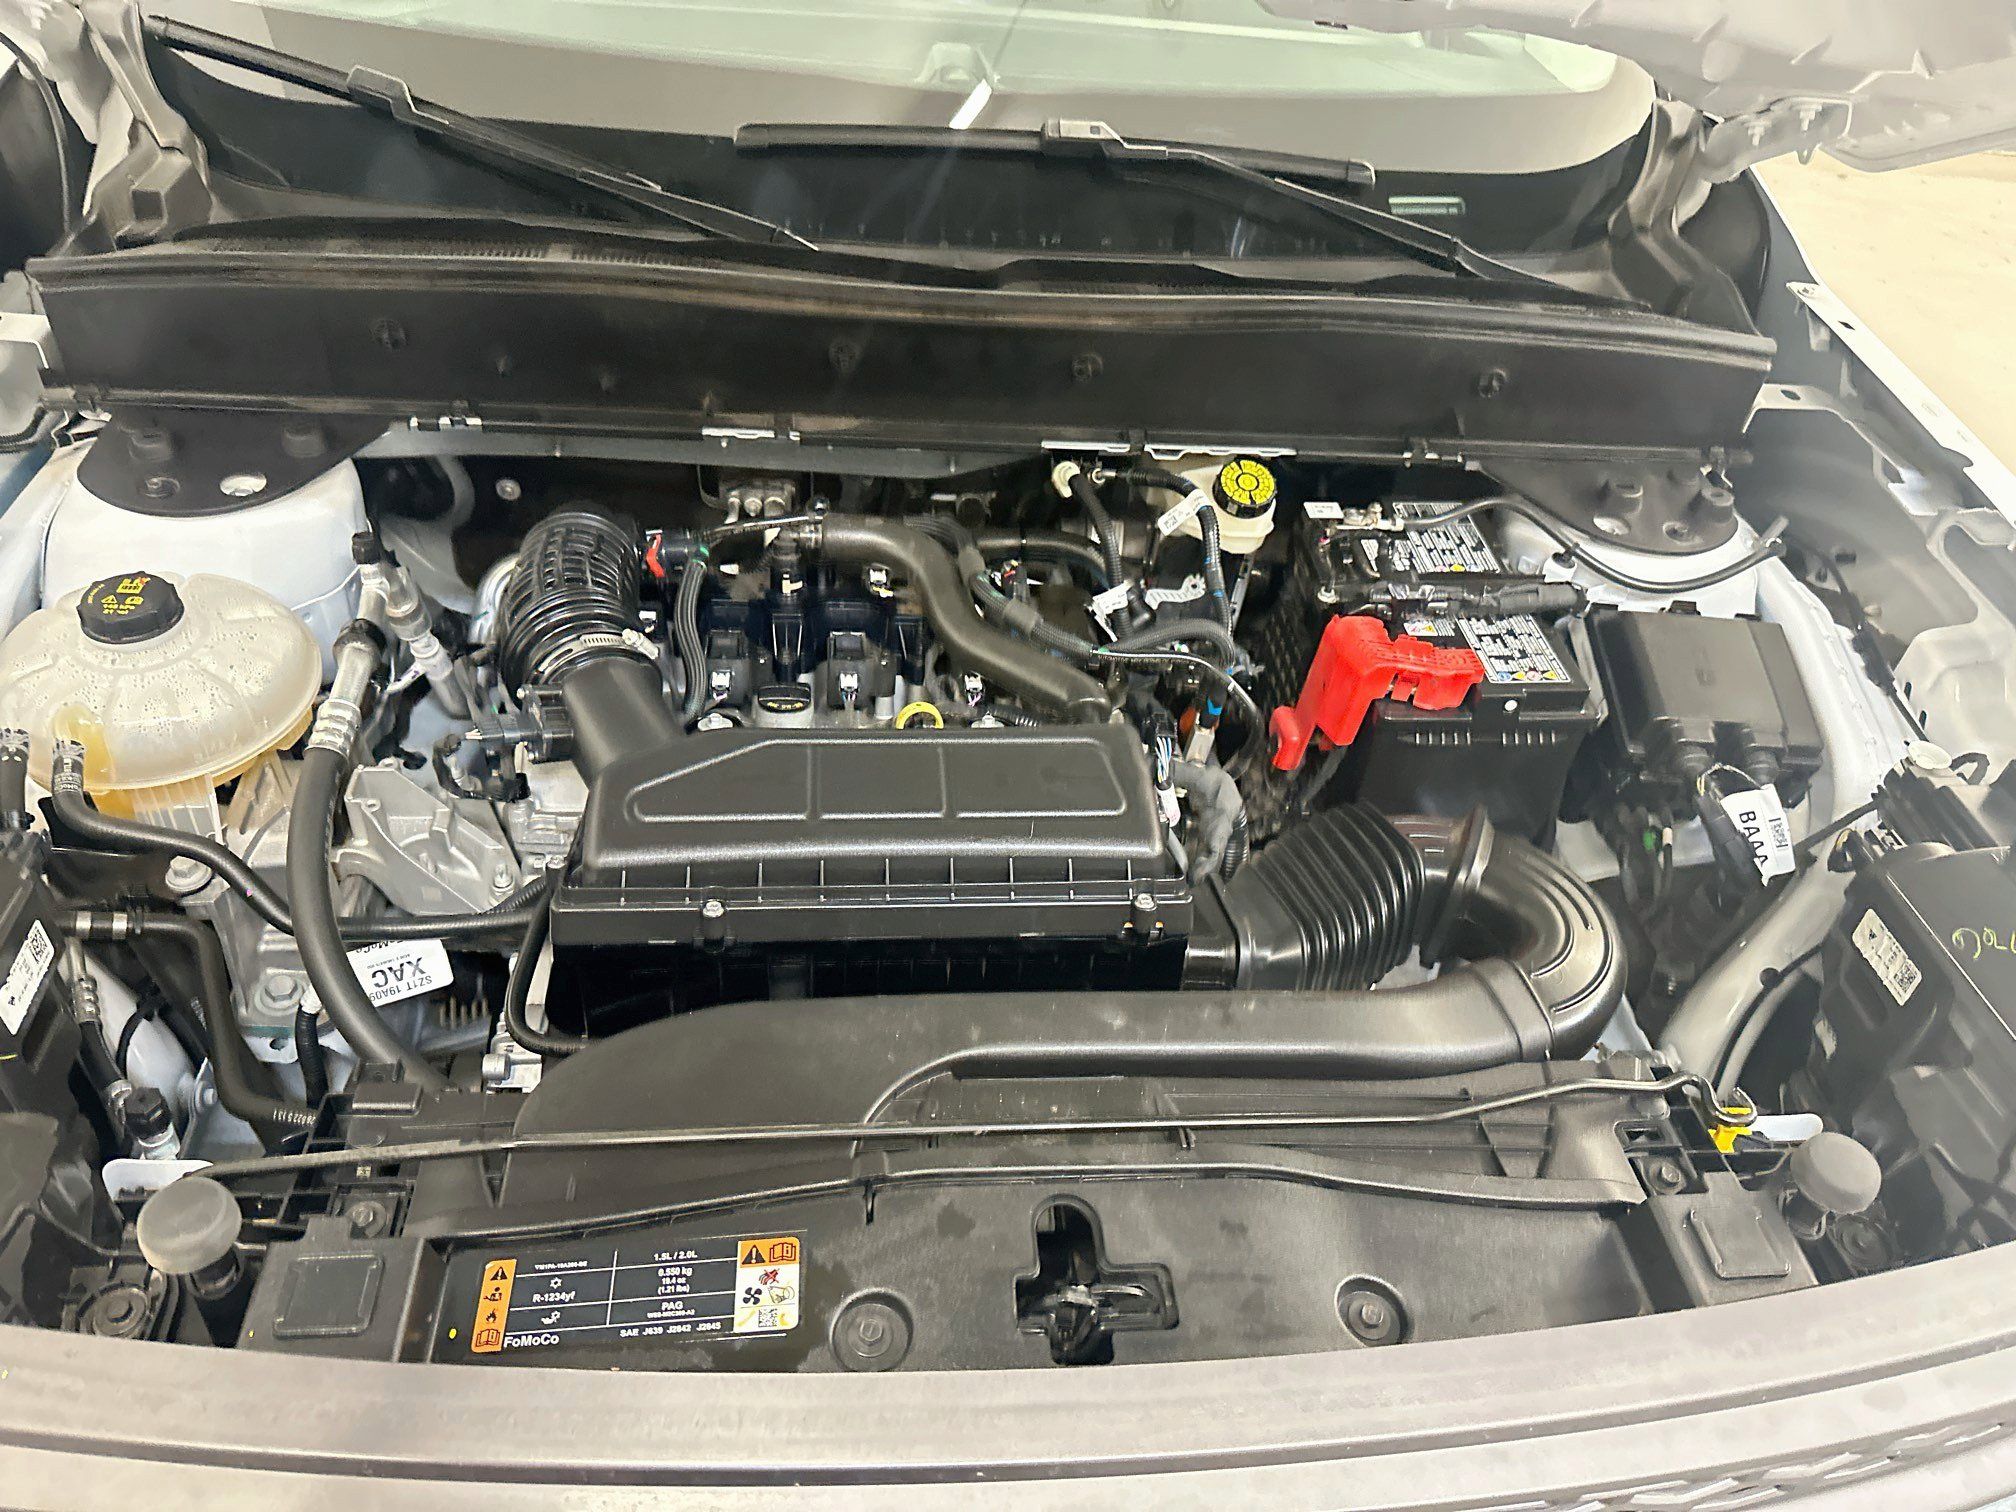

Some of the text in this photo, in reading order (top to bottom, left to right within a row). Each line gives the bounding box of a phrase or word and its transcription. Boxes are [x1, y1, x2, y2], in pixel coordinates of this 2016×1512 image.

[371, 957, 426, 988] XAC
[406, 975, 433, 992] SZ1T
[653, 1252, 672, 1261] 1.5L
[678, 1250, 698, 1259] 2.0L
[681, 1266, 693, 1276] kg
[532, 1290, 576, 1303] R-1234yf
[661, 1300, 683, 1311] PAG
[619, 1328, 639, 1338] SAE
[503, 1335, 560, 1349] FoMoCo
